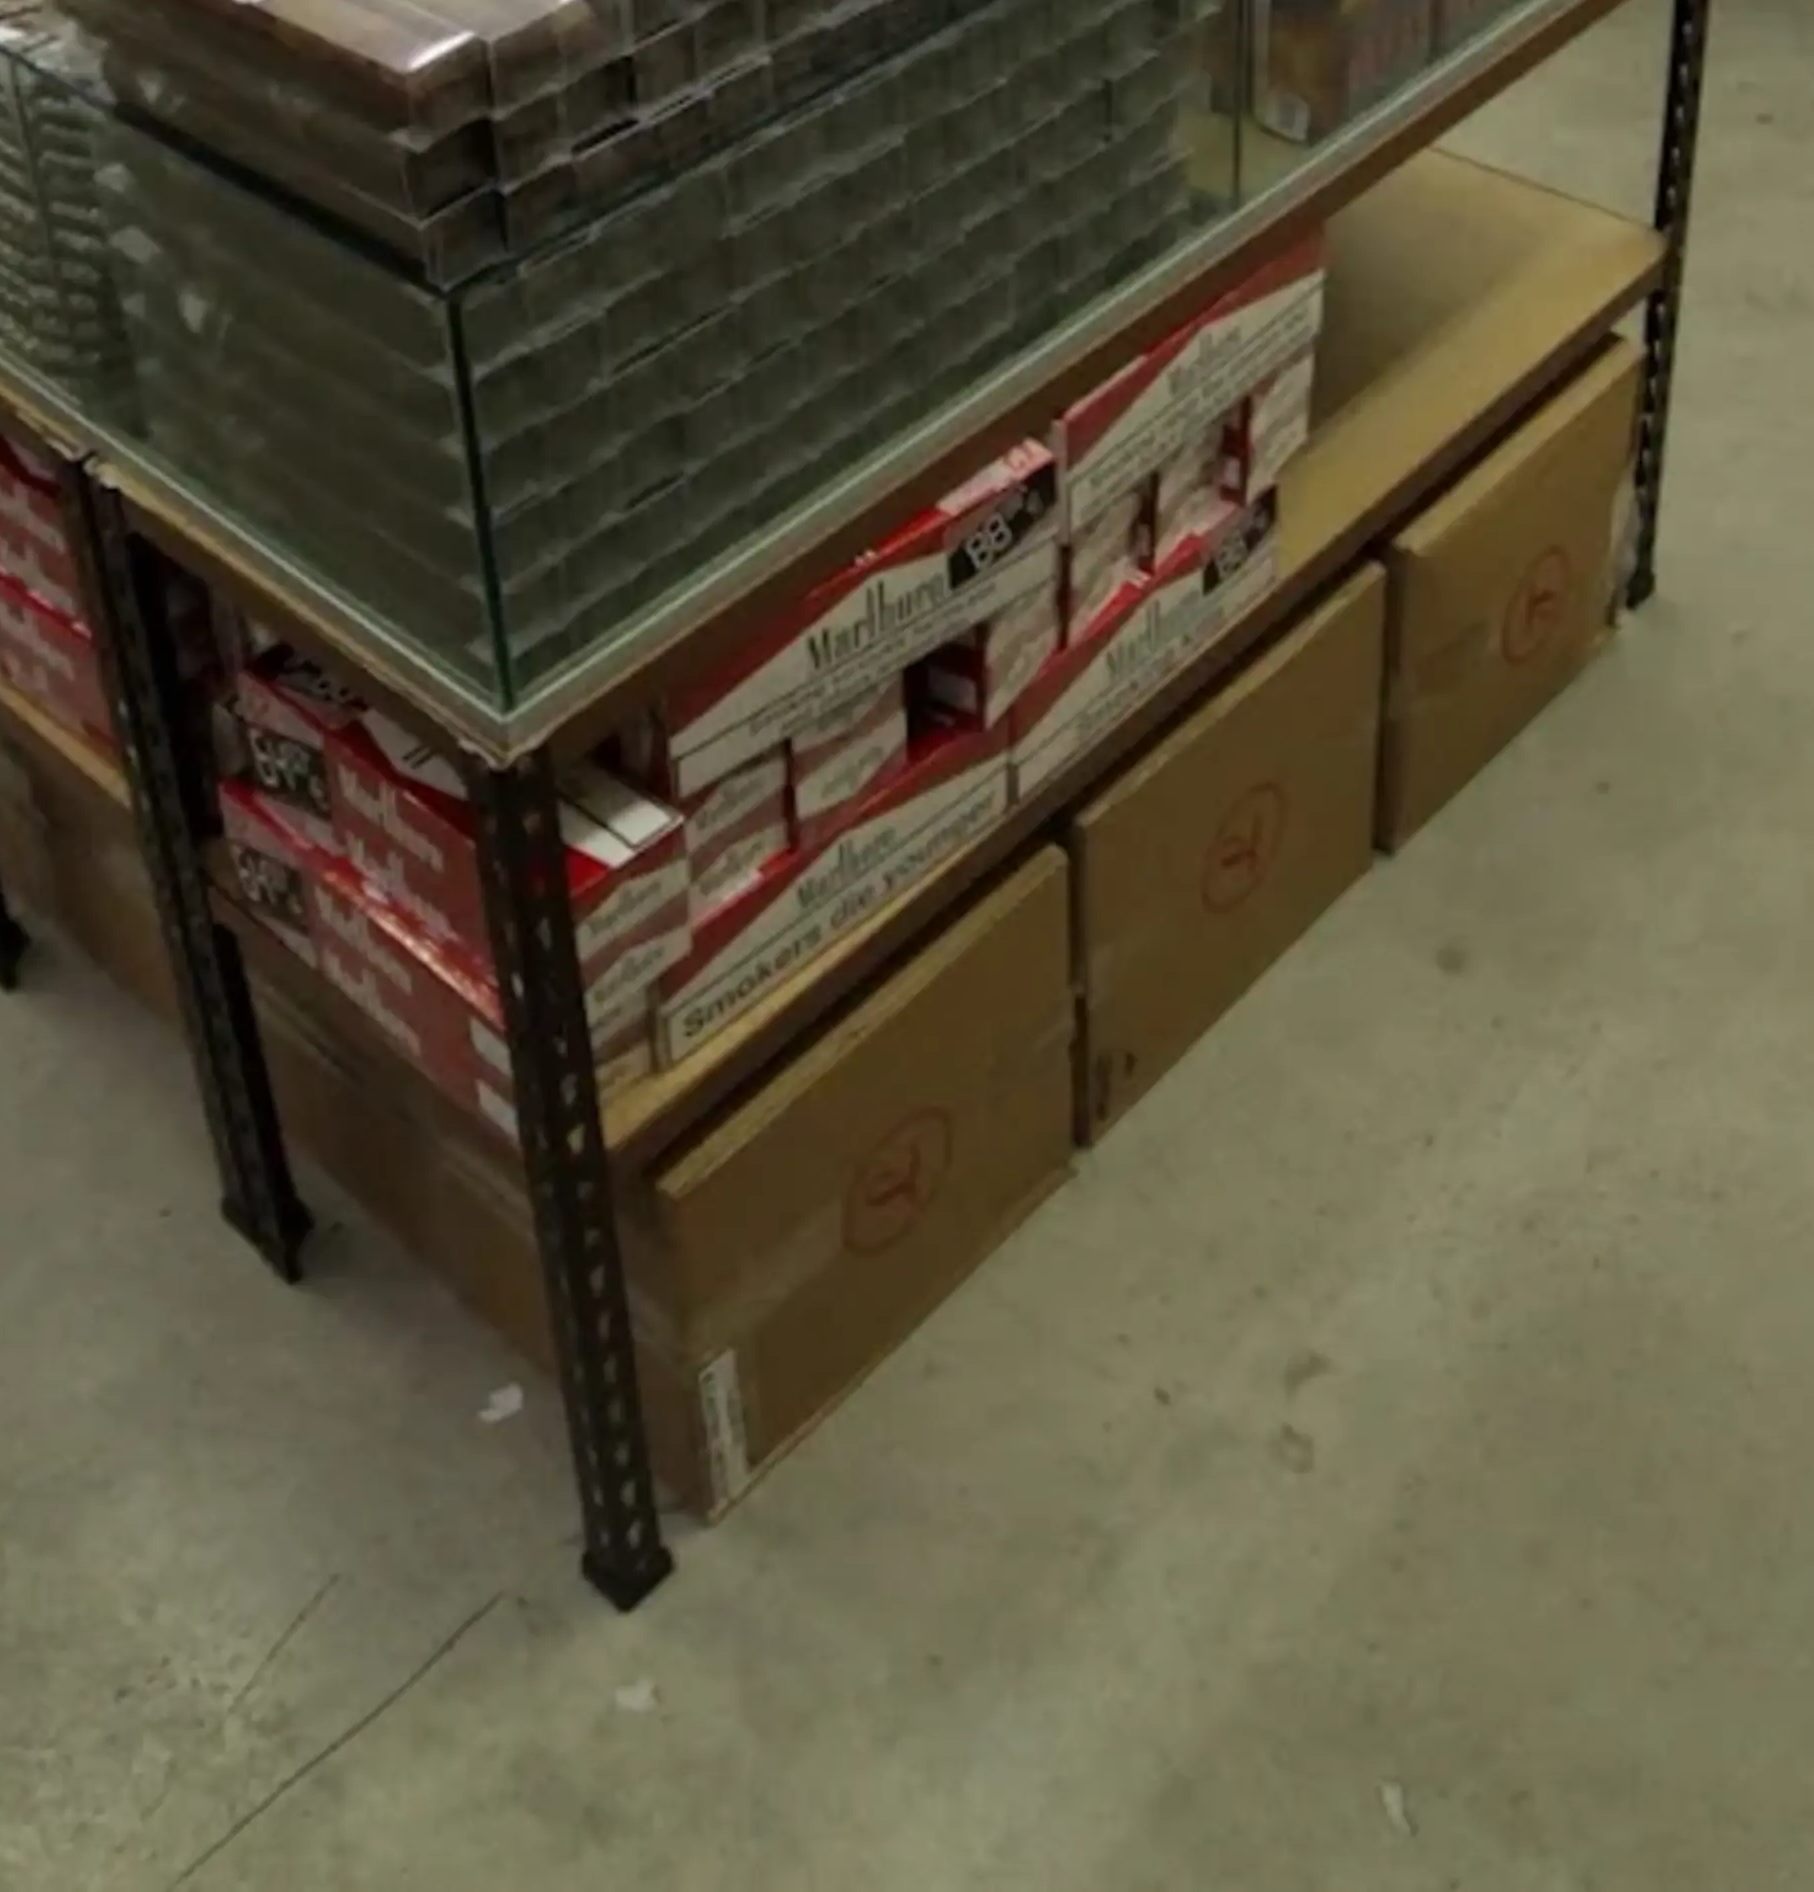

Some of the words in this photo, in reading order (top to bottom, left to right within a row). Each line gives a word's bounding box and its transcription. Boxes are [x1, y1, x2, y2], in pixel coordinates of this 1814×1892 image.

[682, 925, 823, 1038] Smokers
[829, 884, 875, 930] die
[883, 790, 997, 890] younger
